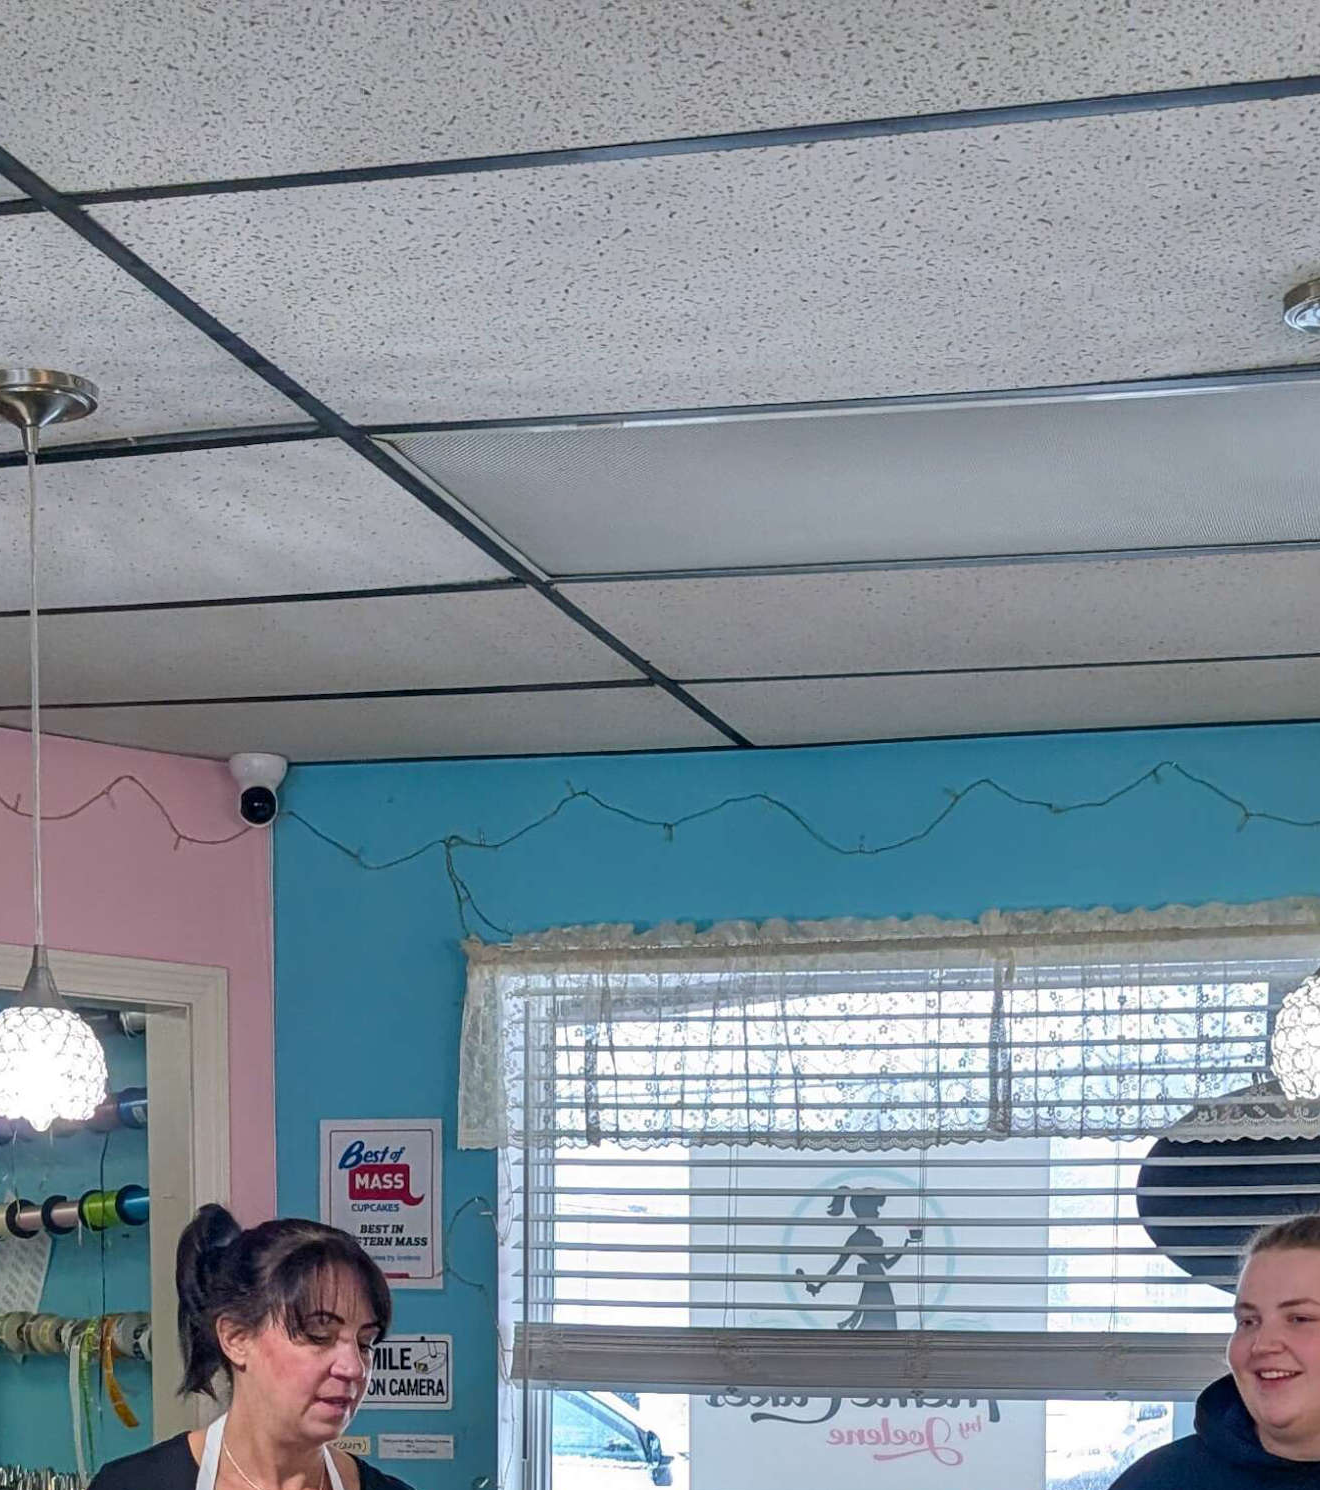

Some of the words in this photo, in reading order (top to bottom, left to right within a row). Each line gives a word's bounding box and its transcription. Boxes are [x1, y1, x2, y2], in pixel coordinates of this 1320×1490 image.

[338, 1140, 389, 1170] Best
[390, 1147, 406, 1163] of
[355, 1173, 405, 1189] MASS
[351, 1203, 400, 1213] CUPCAKES
[360, 1224, 389, 1234] BEST
[391, 1224, 404, 1234] IN
[358, 1237, 393, 1246] TERN
[395, 1237, 428, 1247] MASS
[367, 1379, 386, 1396] ON
[389, 1378, 445, 1397] CAMERA
